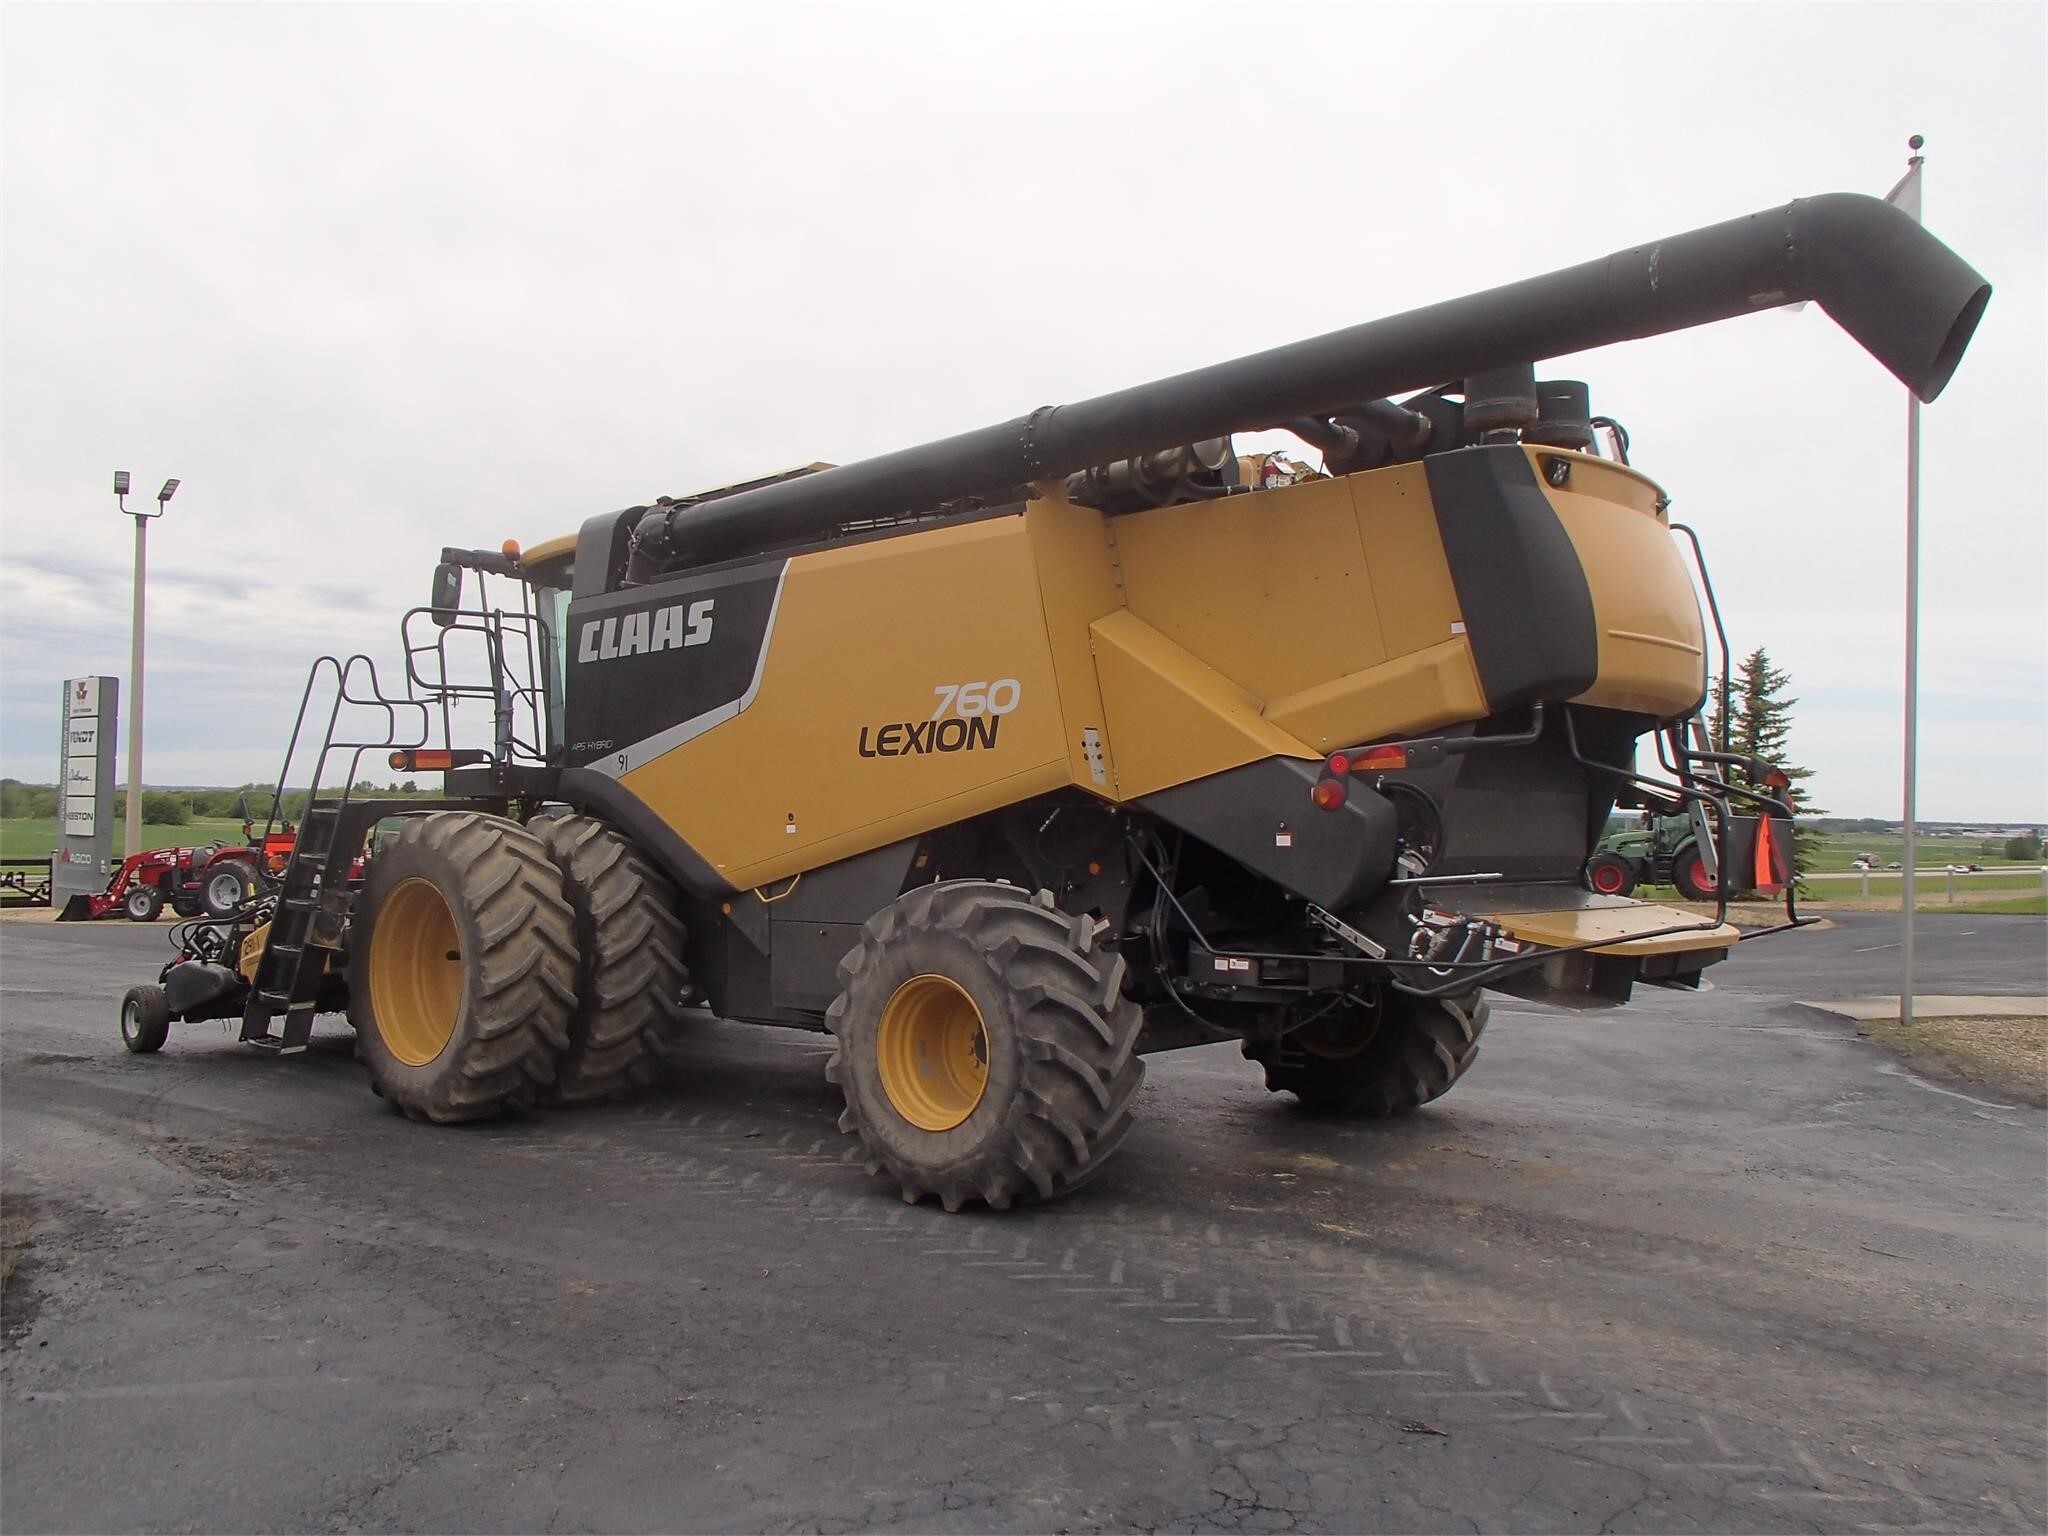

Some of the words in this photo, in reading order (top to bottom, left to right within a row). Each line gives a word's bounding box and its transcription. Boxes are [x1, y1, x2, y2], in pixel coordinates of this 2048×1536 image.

[578, 599, 715, 664] CLAAS
[931, 678, 1021, 721] 760
[587, 739, 614, 750] HYBRID
[858, 715, 1000, 758] LEXION
[618, 754, 629, 771] 91
